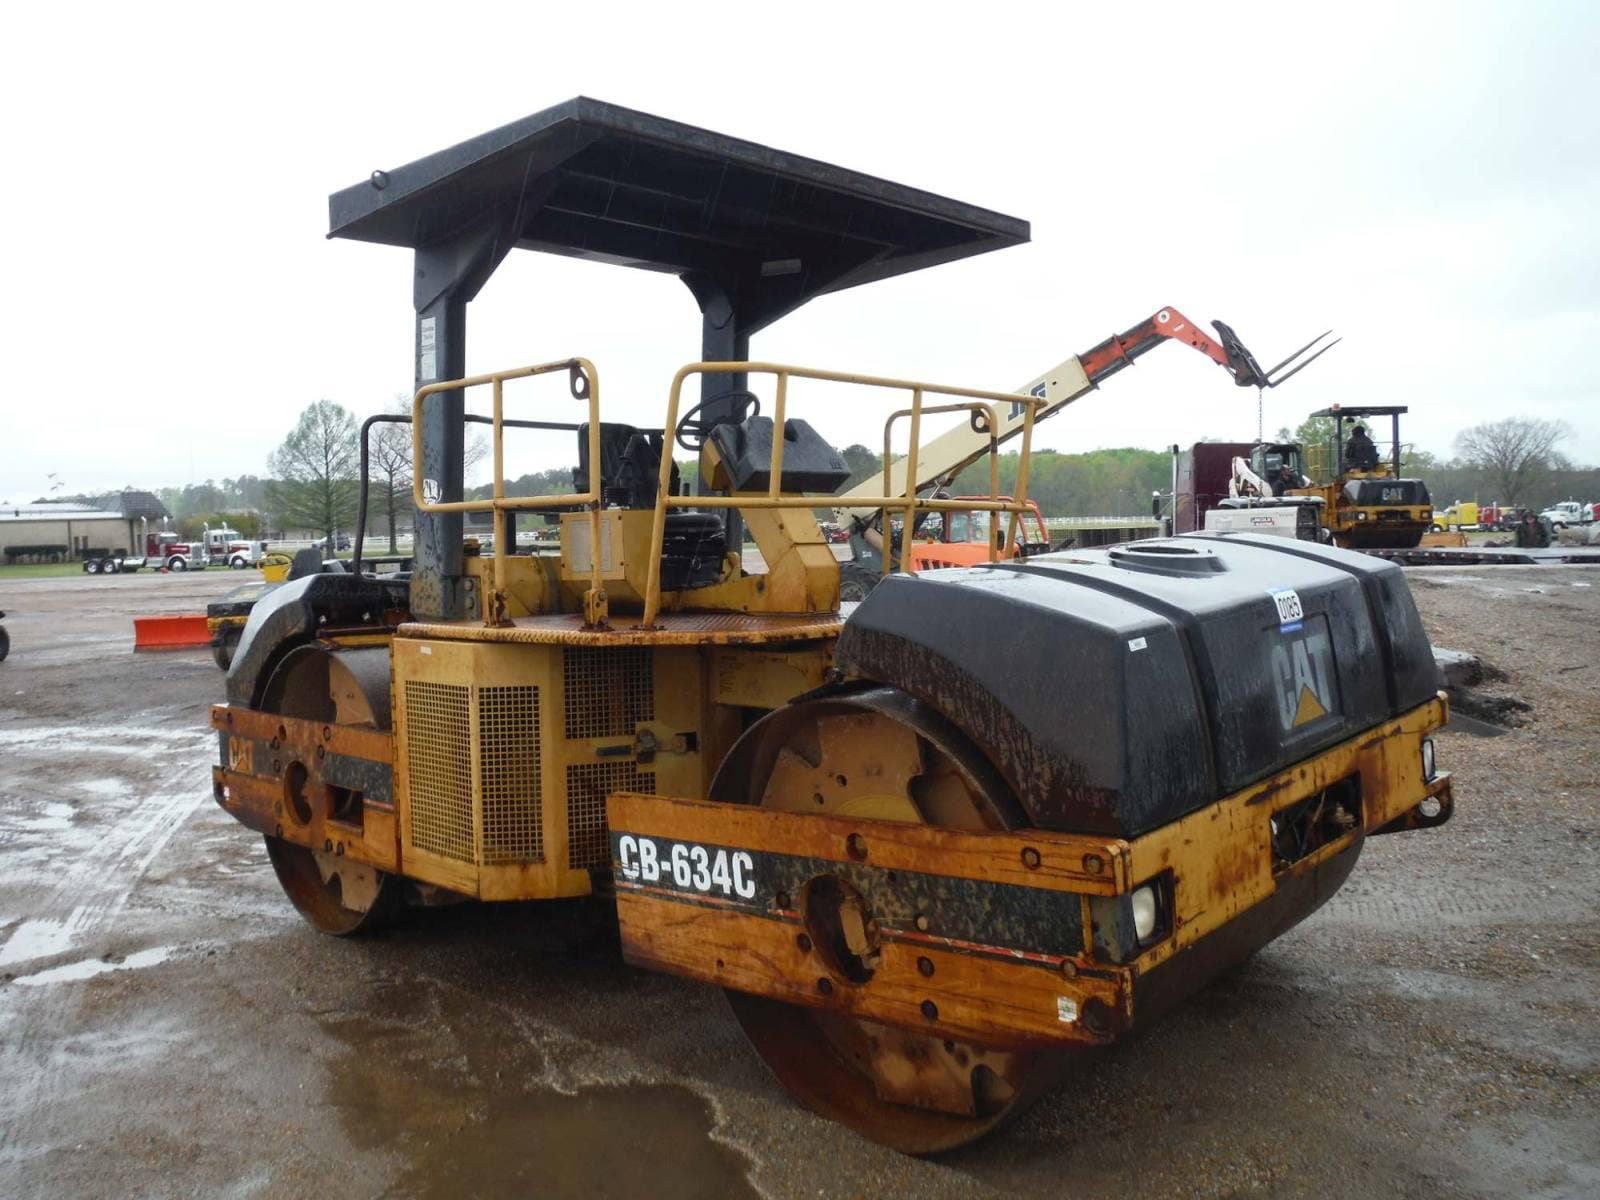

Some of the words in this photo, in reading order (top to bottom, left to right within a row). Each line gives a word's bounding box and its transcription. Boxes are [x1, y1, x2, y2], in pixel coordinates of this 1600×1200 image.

[1382, 487, 1404, 500] CAT
[1278, 595, 1301, 620] 0185
[1271, 632, 1332, 731] CAT
[619, 835, 756, 899] CB-634C
